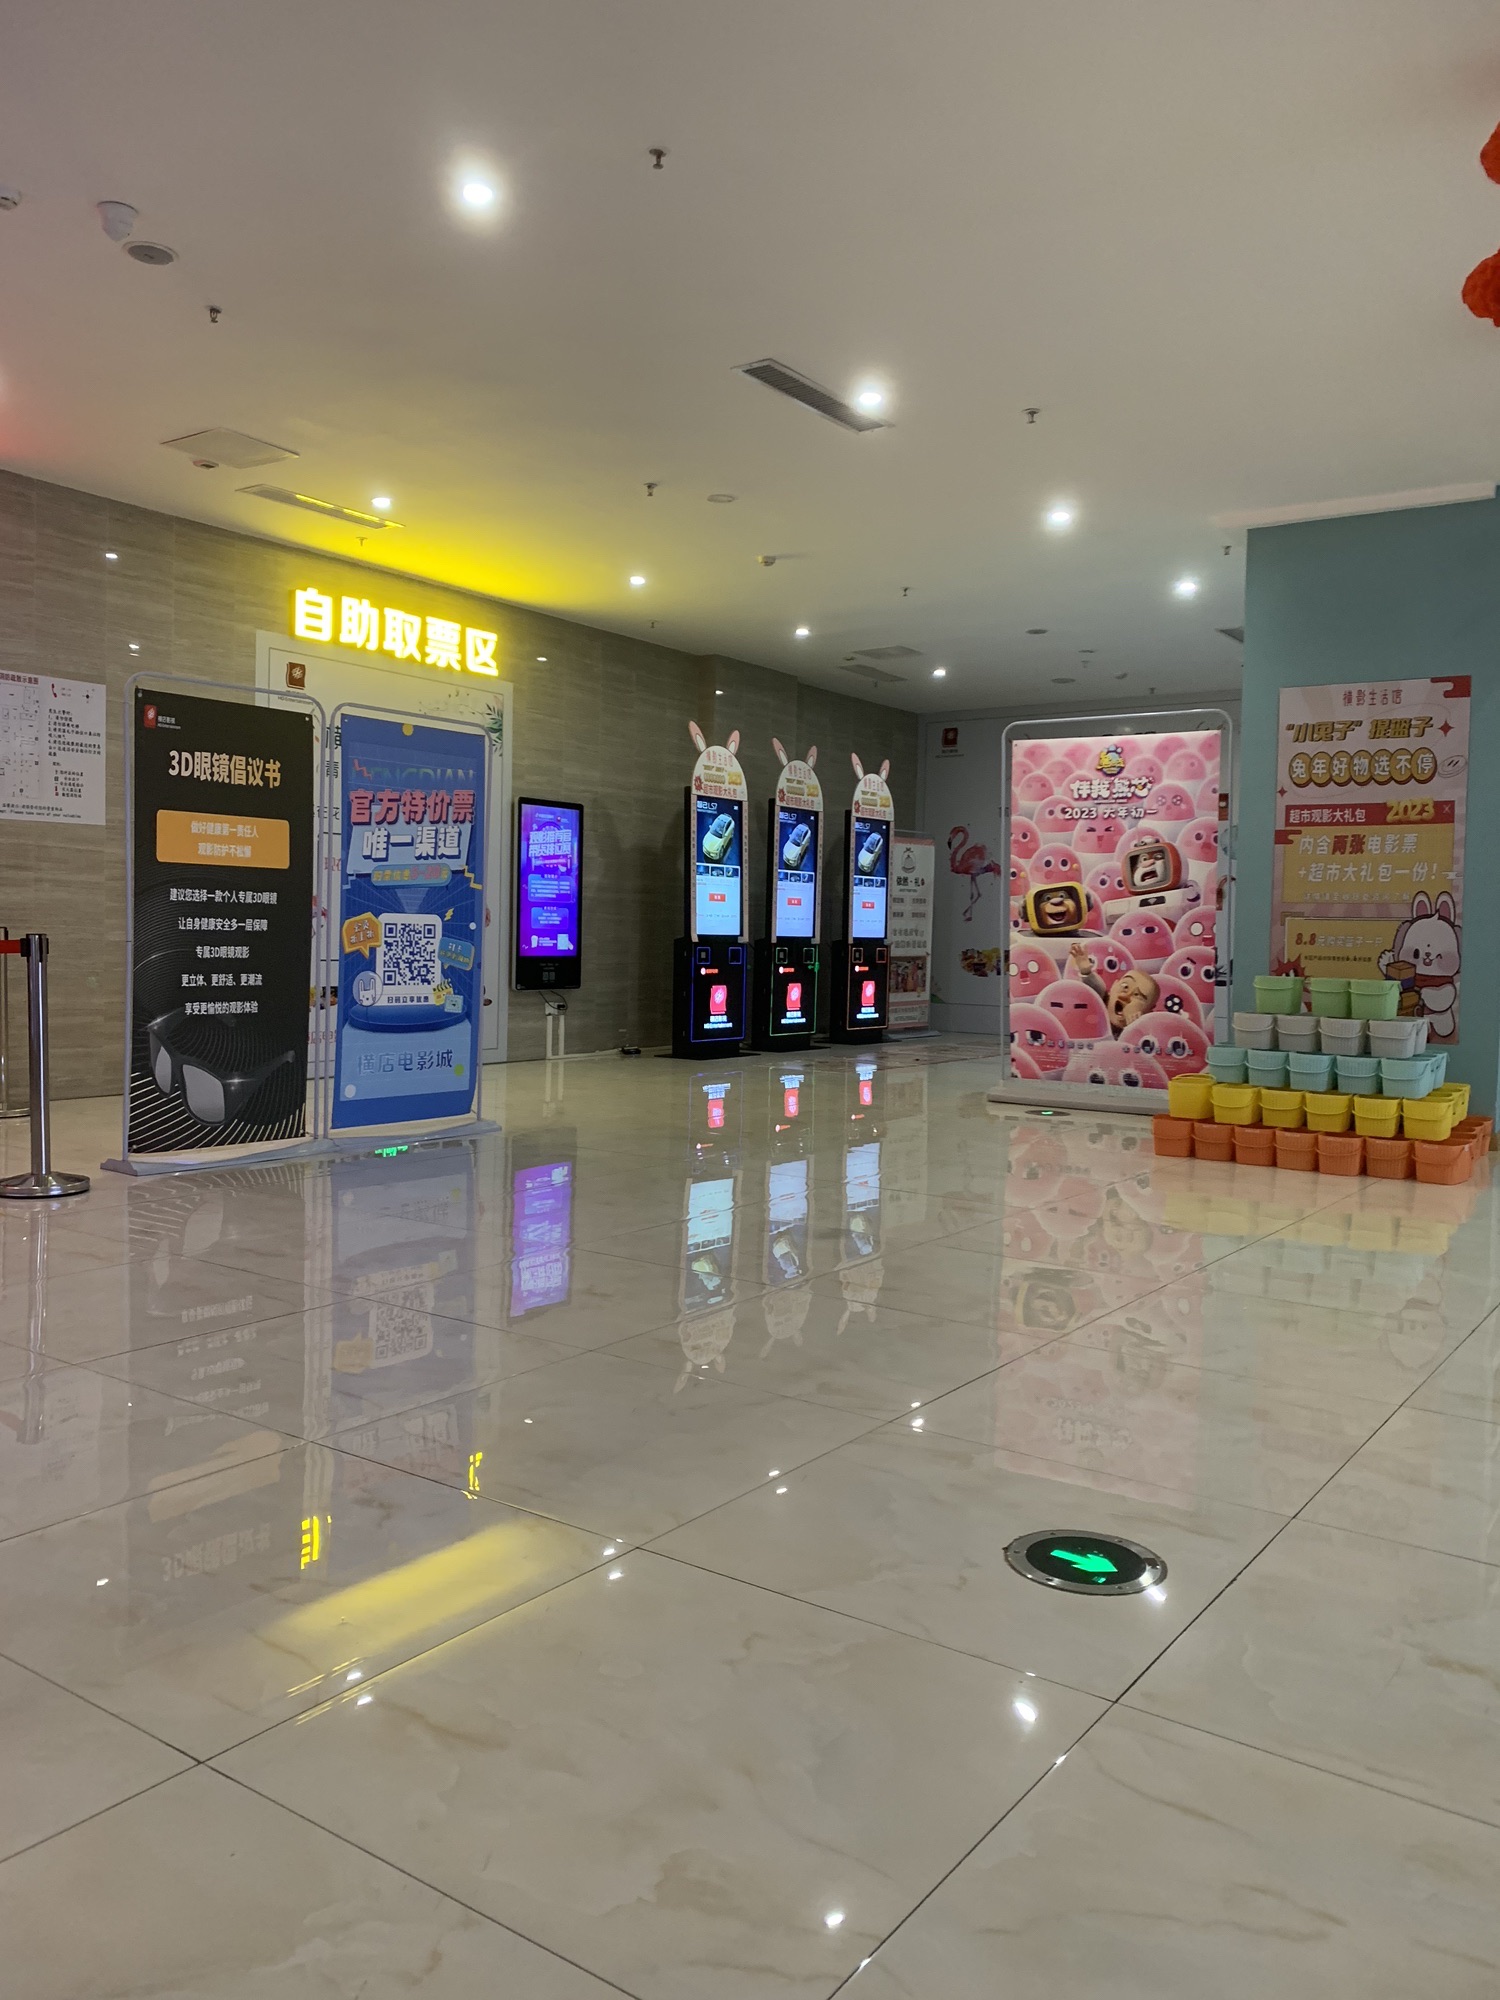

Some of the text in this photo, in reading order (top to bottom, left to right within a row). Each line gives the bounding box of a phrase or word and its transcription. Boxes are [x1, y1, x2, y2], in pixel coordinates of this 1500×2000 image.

[293, 586, 499, 677] 自助取票区
[1368, 716, 1434, 740] 提篮子
[168, 750, 281, 789] 3D眼镜倡议书
[1291, 753, 1434, 778] 兔年好物选不停
[350, 788, 475, 826] 官方特价票
[1064, 806, 1158, 820] 2023 大年初一
[1289, 807, 1366, 824] 超市观影大礼包
[1386, 799, 1435, 823] 2023
[362, 825, 462, 862] 唯一渠道
[1300, 833, 1419, 856] 内含两张电影票
[170, 888, 278, 905] 建议您选择一款个人专属3D眼镜
[178, 917, 268, 932] 让自身健康安全多一层保障
[195, 945, 250, 959] 专属3D眼镜观影
[181, 973, 263, 987] 更立体、更舒适、更潮流
[185, 1001, 259, 1016] 享受更愉悦的观影体验
[358, 1049, 453, 1076] 横店电影城
